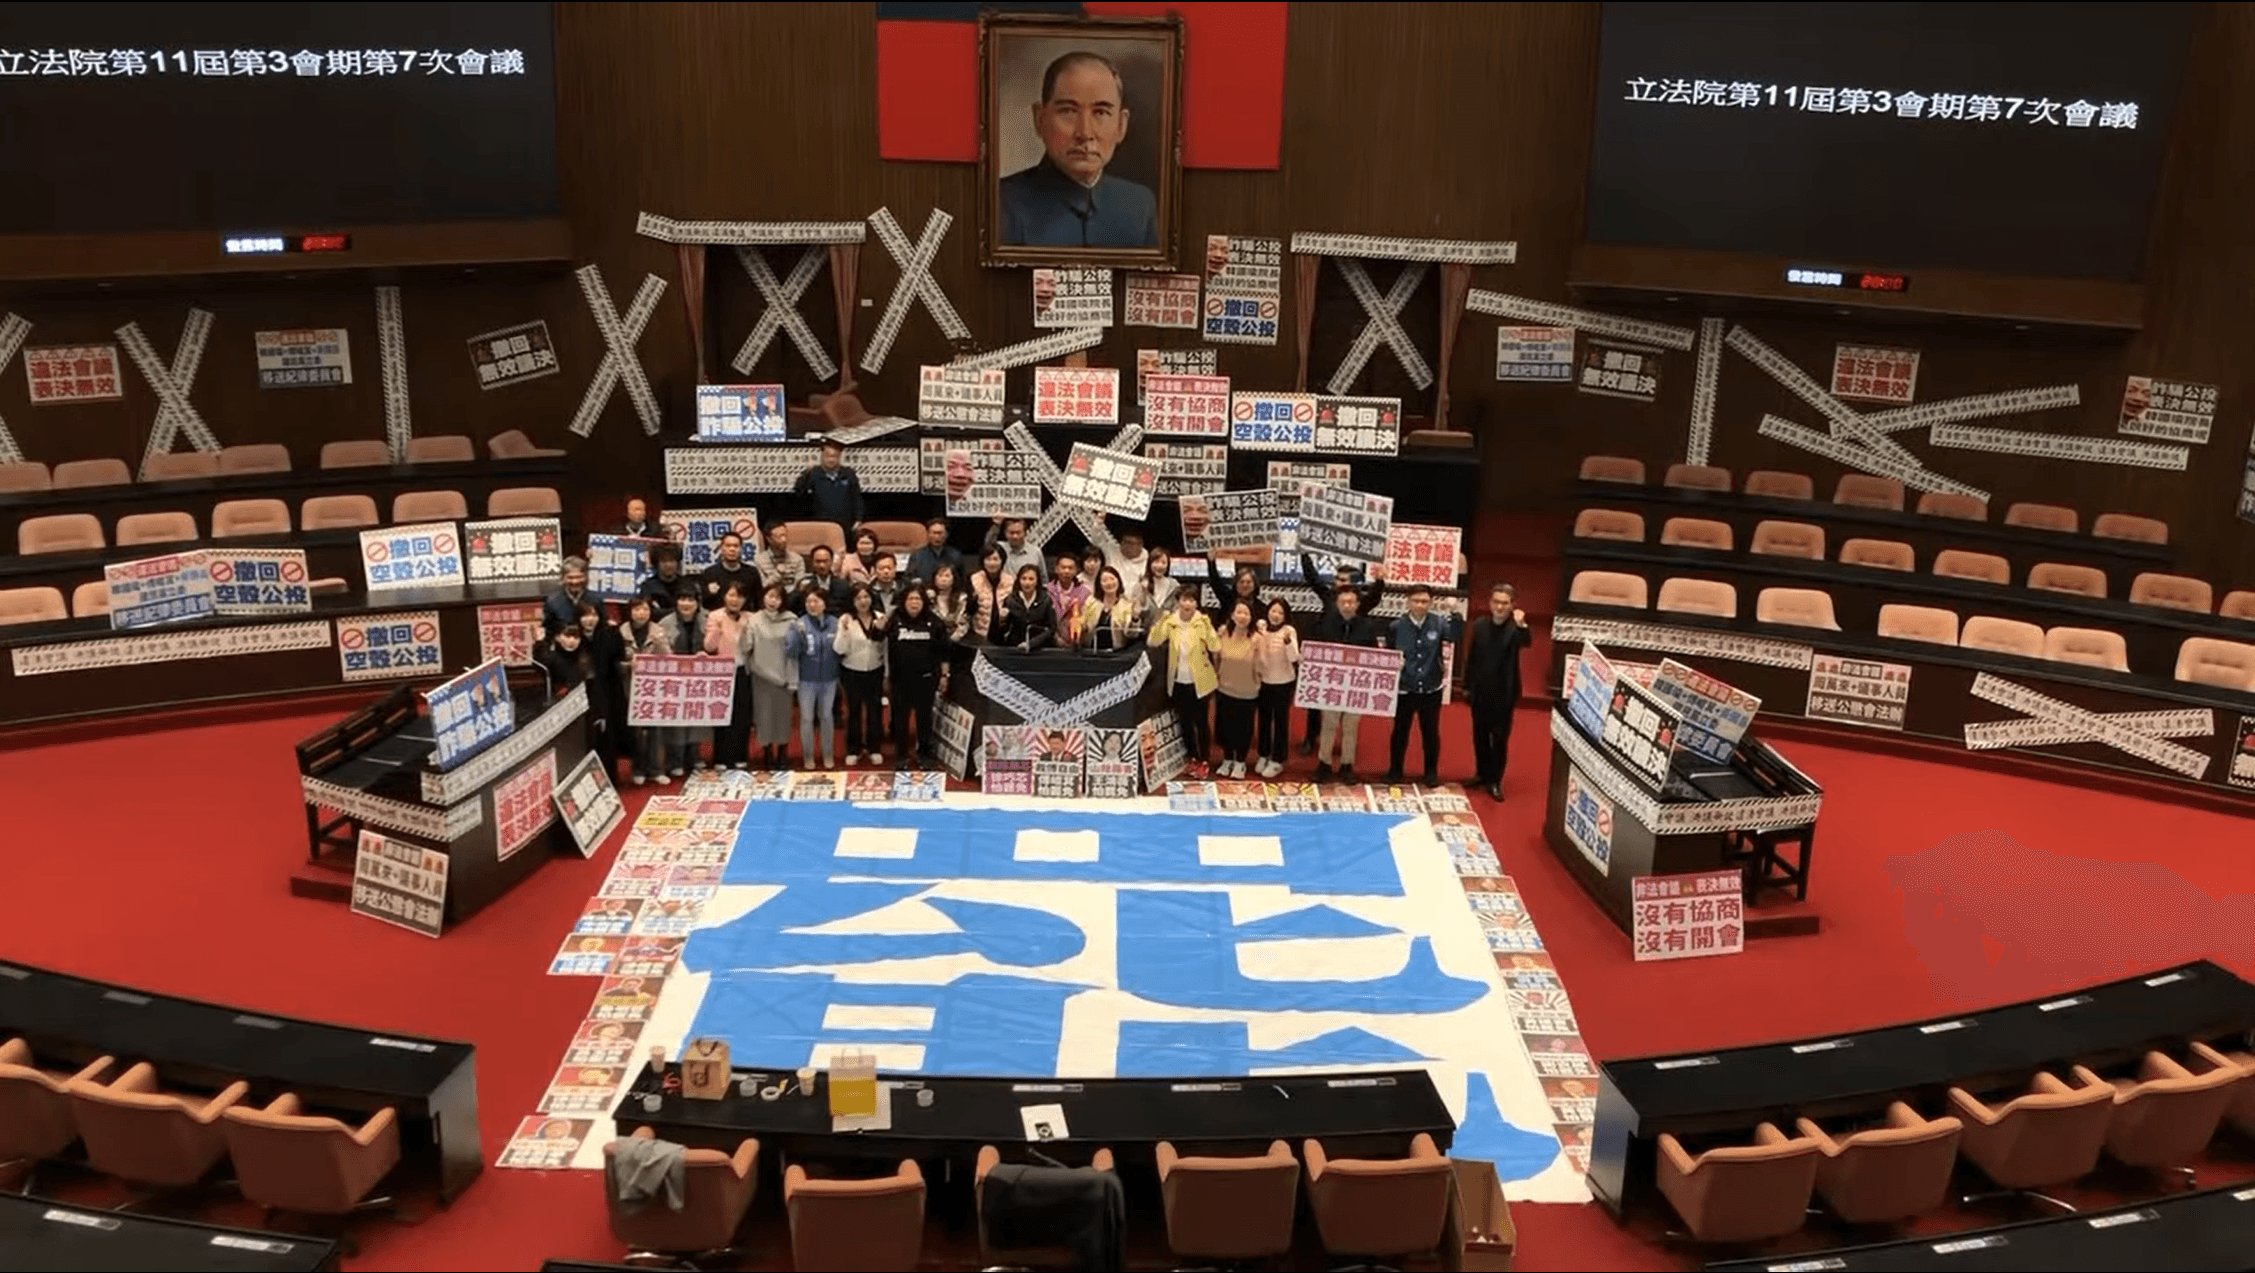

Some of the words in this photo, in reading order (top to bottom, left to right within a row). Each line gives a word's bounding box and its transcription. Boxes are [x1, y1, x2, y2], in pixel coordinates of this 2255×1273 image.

[0, 46, 524, 76] 立法院第11屆第3會期第7次會議
[1625, 76, 2138, 130] 立法院第11屆第3會期第7次會議
[1225, 299, 1259, 318] 撤回
[1206, 318, 1276, 338] 空殼公投
[1147, 395, 1226, 413] 沒有協商
[1253, 402, 1293, 422] 撤回
[1148, 414, 1226, 432] 沒有開會
[1233, 422, 1313, 444] 空殼公投
[688, 520, 732, 542] 撤回
[389, 536, 433, 559] 撤回
[234, 561, 280, 582] 撤回
[370, 557, 459, 583] 空殼公投
[214, 585, 308, 606] 空殼公投
[366, 625, 413, 646] 撤回
[344, 645, 440, 671] 空殼公投
[632, 677, 732, 699] 沒有協商
[1300, 664, 1397, 692] 沒有協商
[1298, 685, 1392, 711] 沒有開會
[631, 700, 729, 721] 沒有開會
[1636, 897, 1740, 926] 沒有協商
[1636, 924, 1740, 953] 沒有開會
